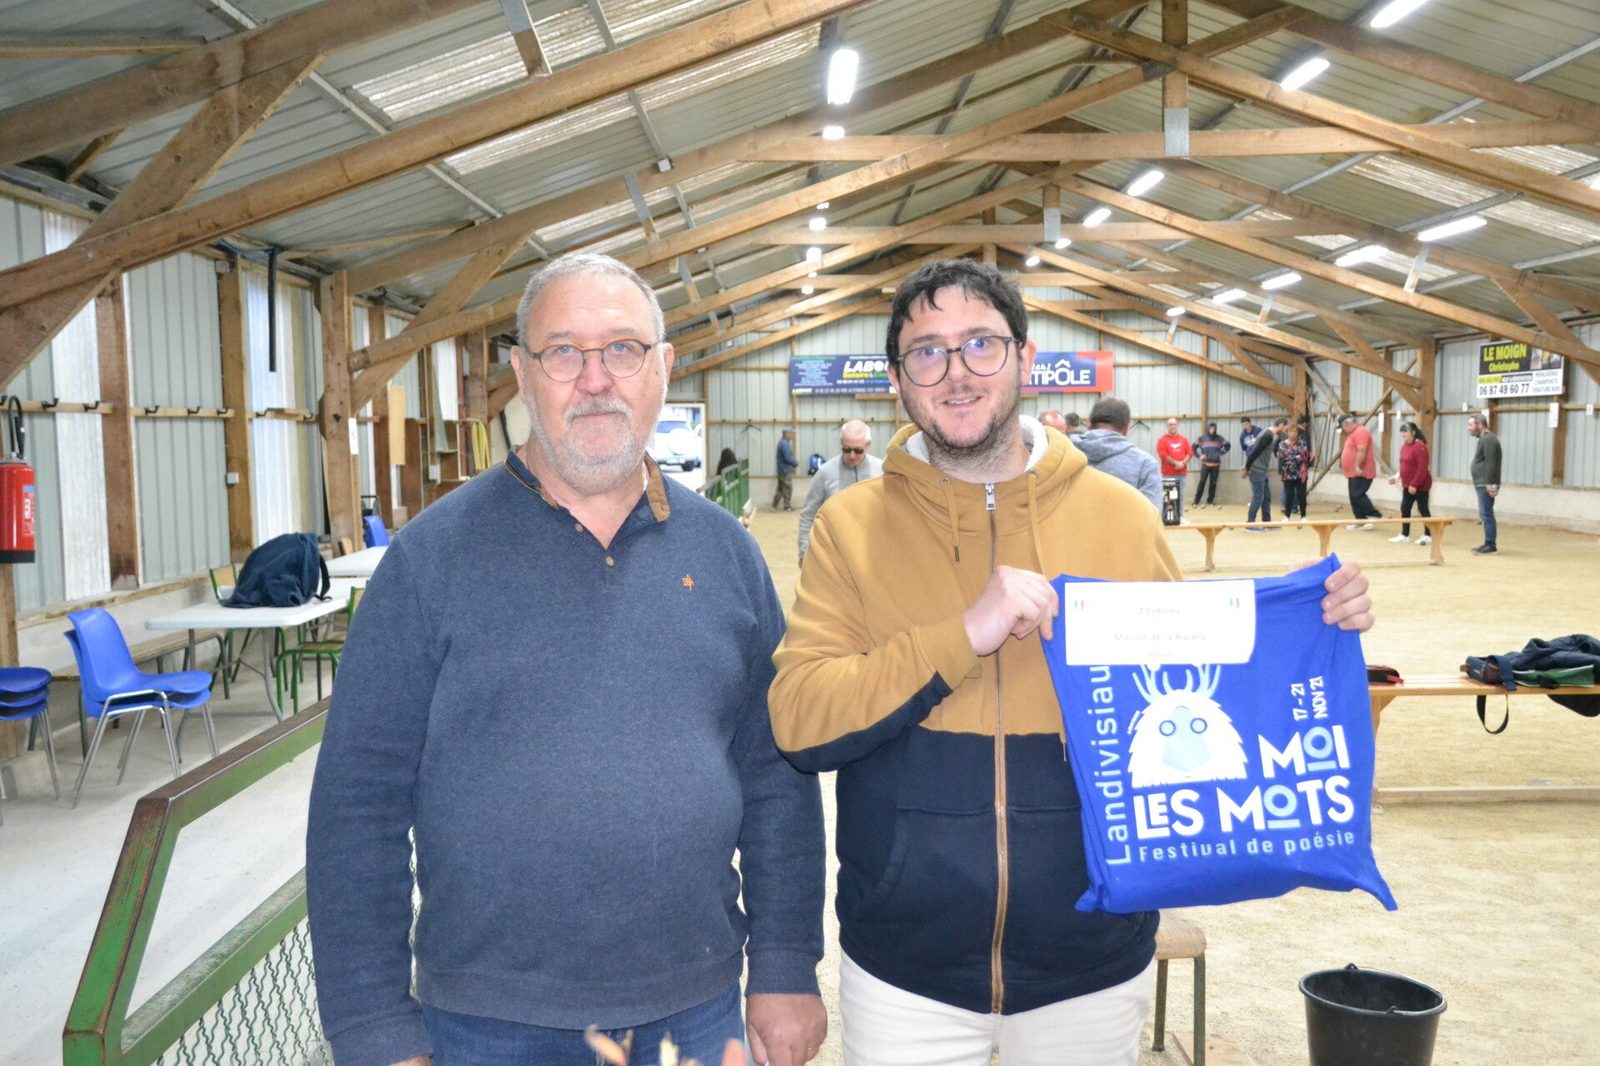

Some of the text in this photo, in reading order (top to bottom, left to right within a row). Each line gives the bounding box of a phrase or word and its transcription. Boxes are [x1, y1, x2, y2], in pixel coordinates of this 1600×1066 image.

[1483, 343, 1527, 361] LE MOIGN
[1028, 359, 1091, 386] TIPÔLE
[1521, 383, 1530, 393] 77
[1311, 691, 1328, 719] NOV
[1087, 665, 1131, 865] Landivisiau
[1258, 725, 1350, 778] MOI
[1133, 775, 1354, 840] LES MOTS
[1138, 830, 1355, 862] Festival de poésie
